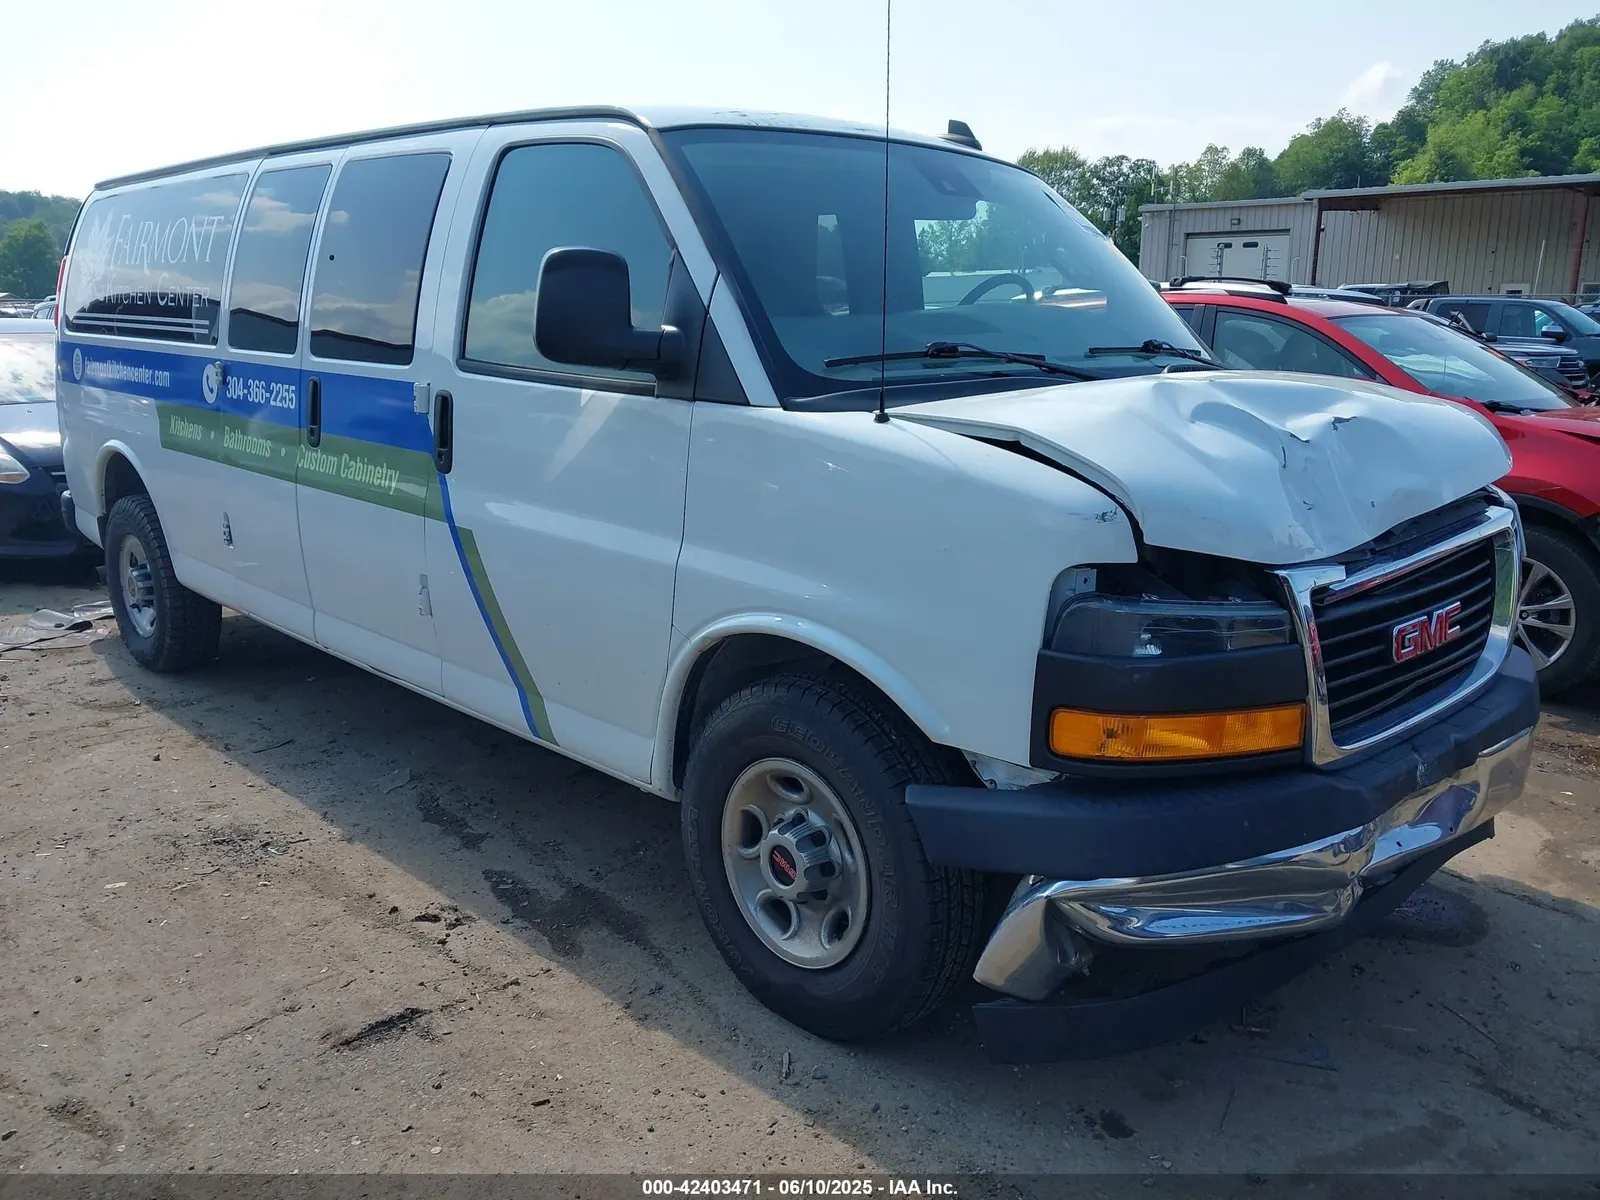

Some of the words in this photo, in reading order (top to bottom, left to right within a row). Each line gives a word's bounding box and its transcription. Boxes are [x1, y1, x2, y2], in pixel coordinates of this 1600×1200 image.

[110, 214, 224, 275] FAIRMONT
[157, 272, 210, 307] CENTER
[226, 375, 296, 409] 304-366-2255
[169, 414, 203, 441] Kitchens
[223, 426, 272, 458] Bathrooms
[296, 444, 338, 475] Custom
[340, 453, 400, 495] Cabinetry
[1393, 601, 1462, 663] GMC
[772, 850, 798, 880] GMC
